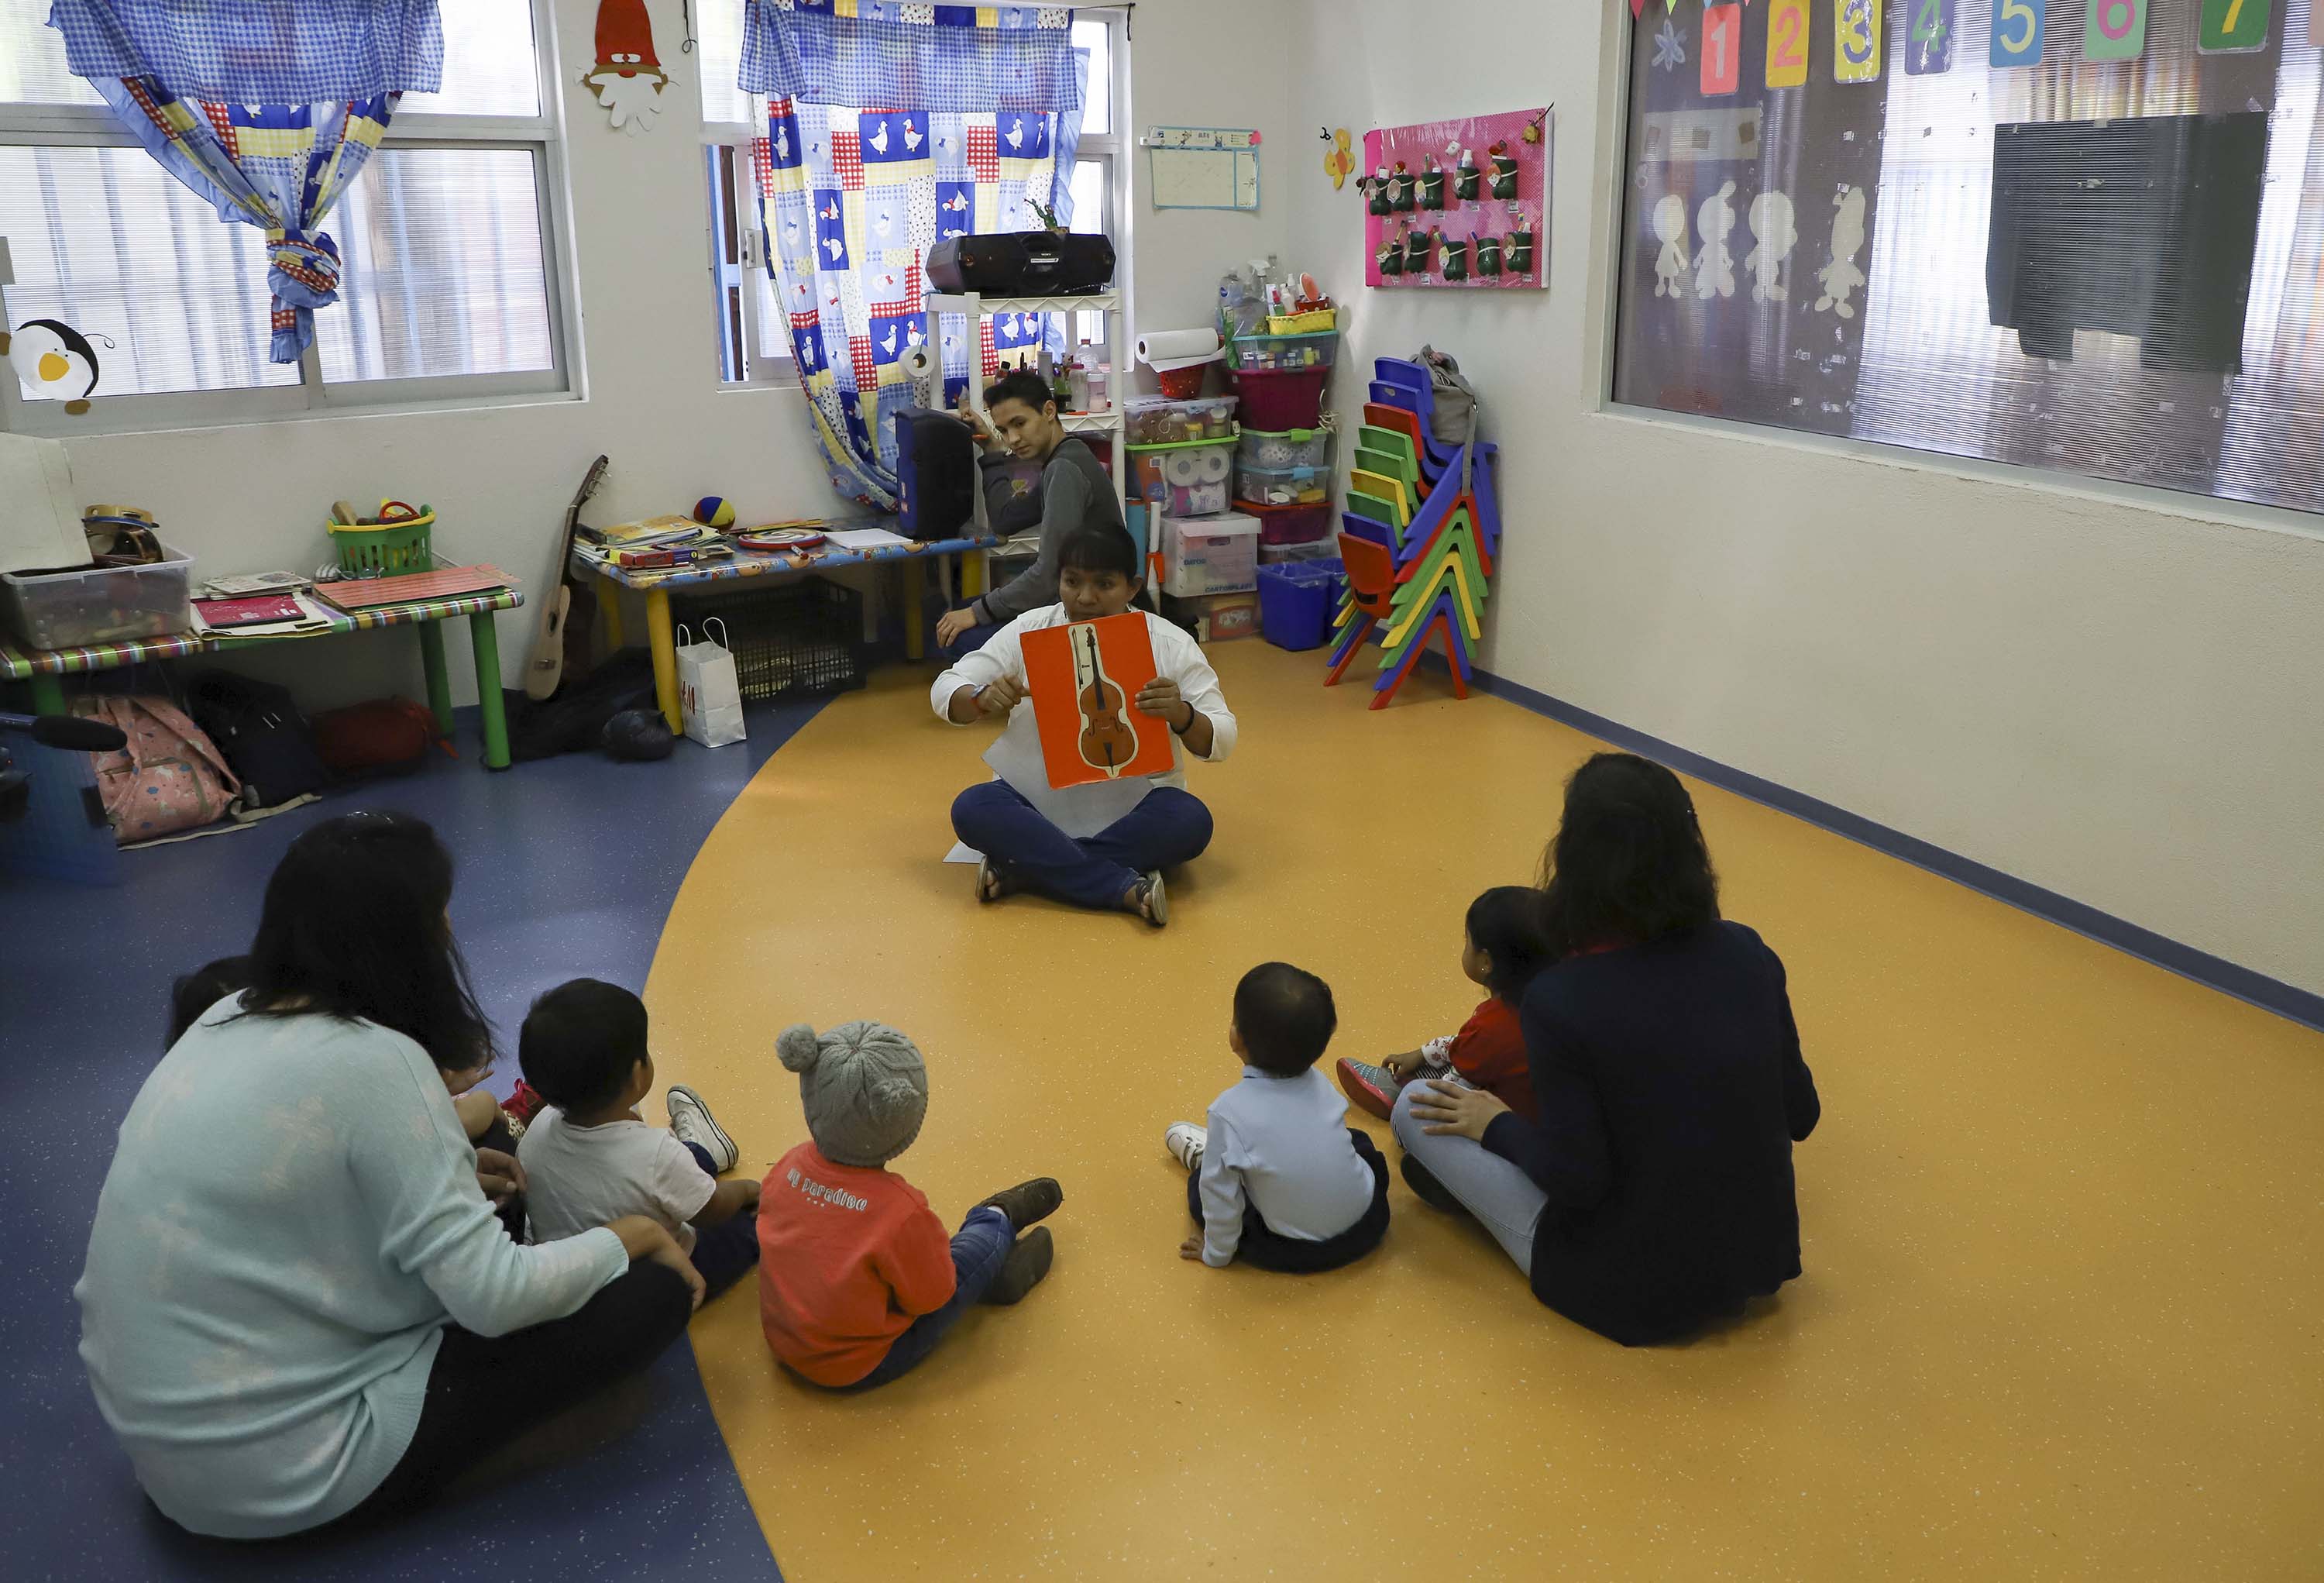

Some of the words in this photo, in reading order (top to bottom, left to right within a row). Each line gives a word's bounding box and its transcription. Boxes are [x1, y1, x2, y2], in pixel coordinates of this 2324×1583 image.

[1710, 21, 1726, 80] 1
[1772, 6, 1803, 68] 2
[1841, 0, 1873, 64] 3
[1912, 0, 1947, 53] 4
[1999, 0, 2036, 53] 5
